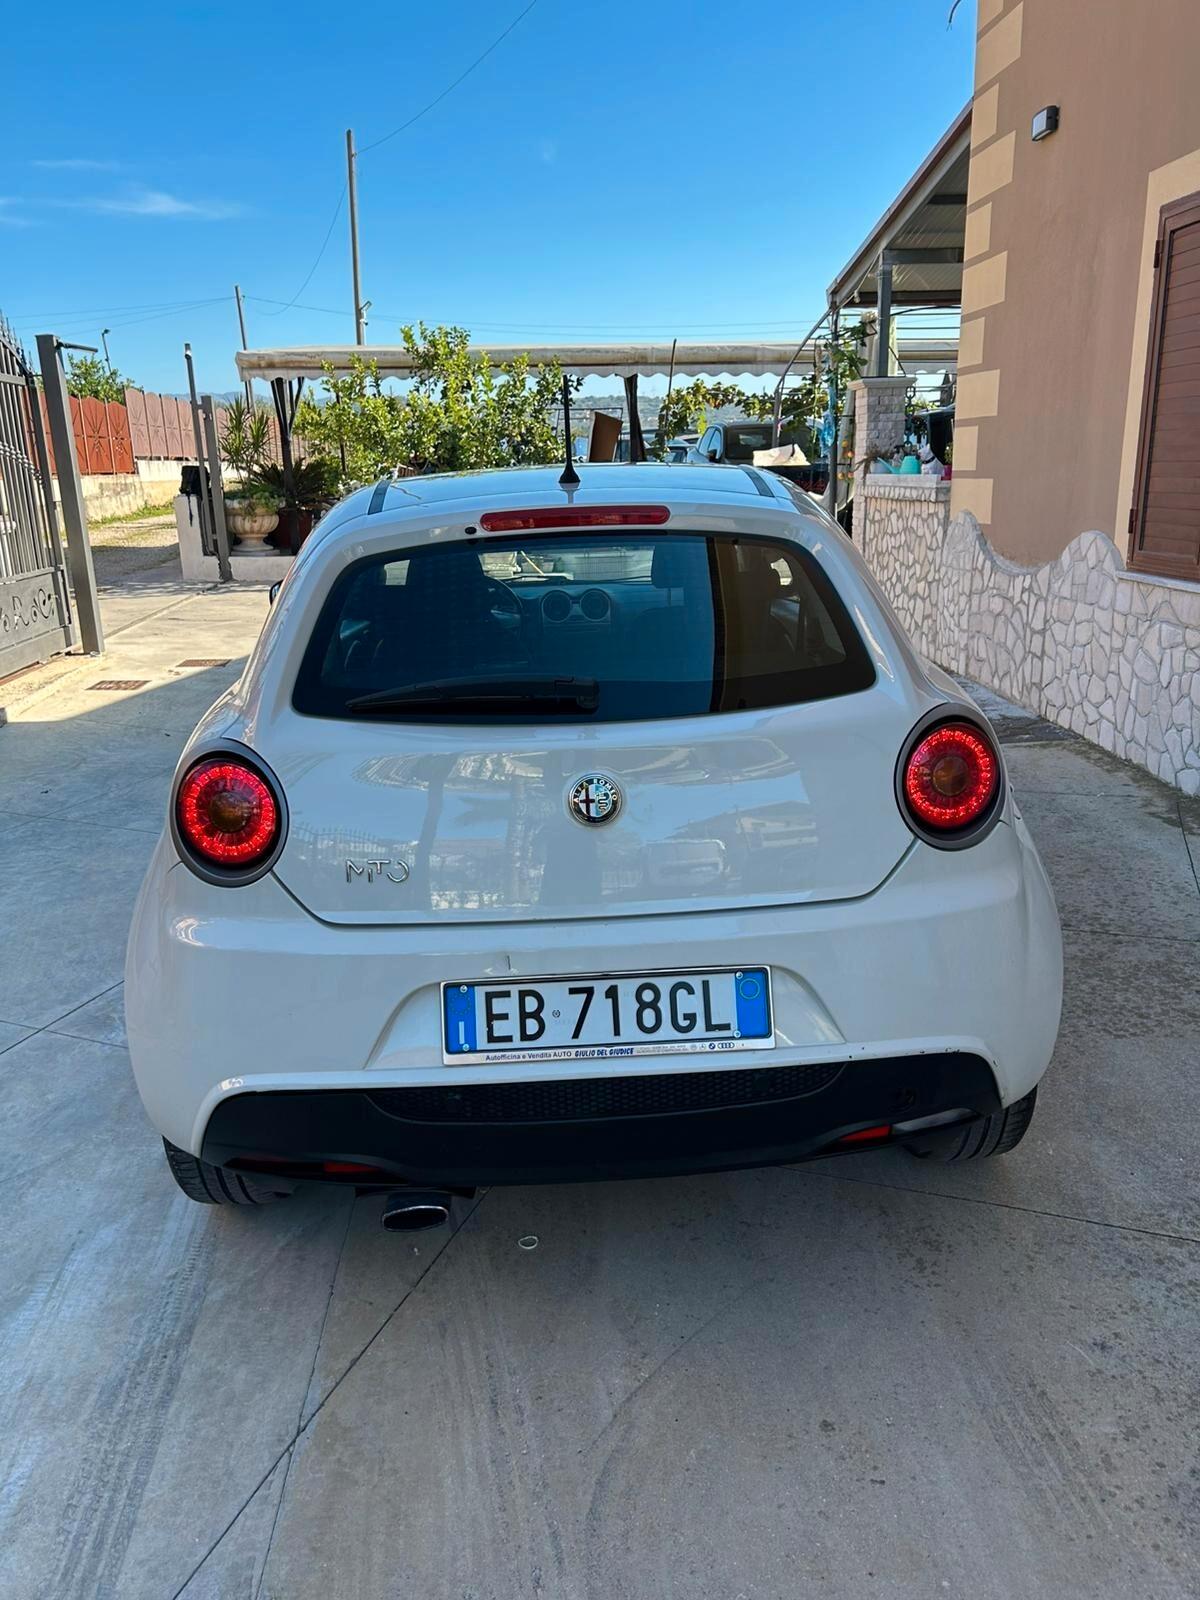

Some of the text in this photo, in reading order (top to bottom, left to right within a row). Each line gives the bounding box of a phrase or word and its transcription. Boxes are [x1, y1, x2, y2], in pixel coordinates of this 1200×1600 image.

[573, 778, 618, 803] ALFA ROMEO
[484, 980, 731, 1044] EB 718GL
[485, 1053, 521, 1062] Autofficina
[527, 1051, 552, 1059] Vendita
[575, 1049, 596, 1057] GIULIO
[609, 1047, 634, 1056] GIUDICE
